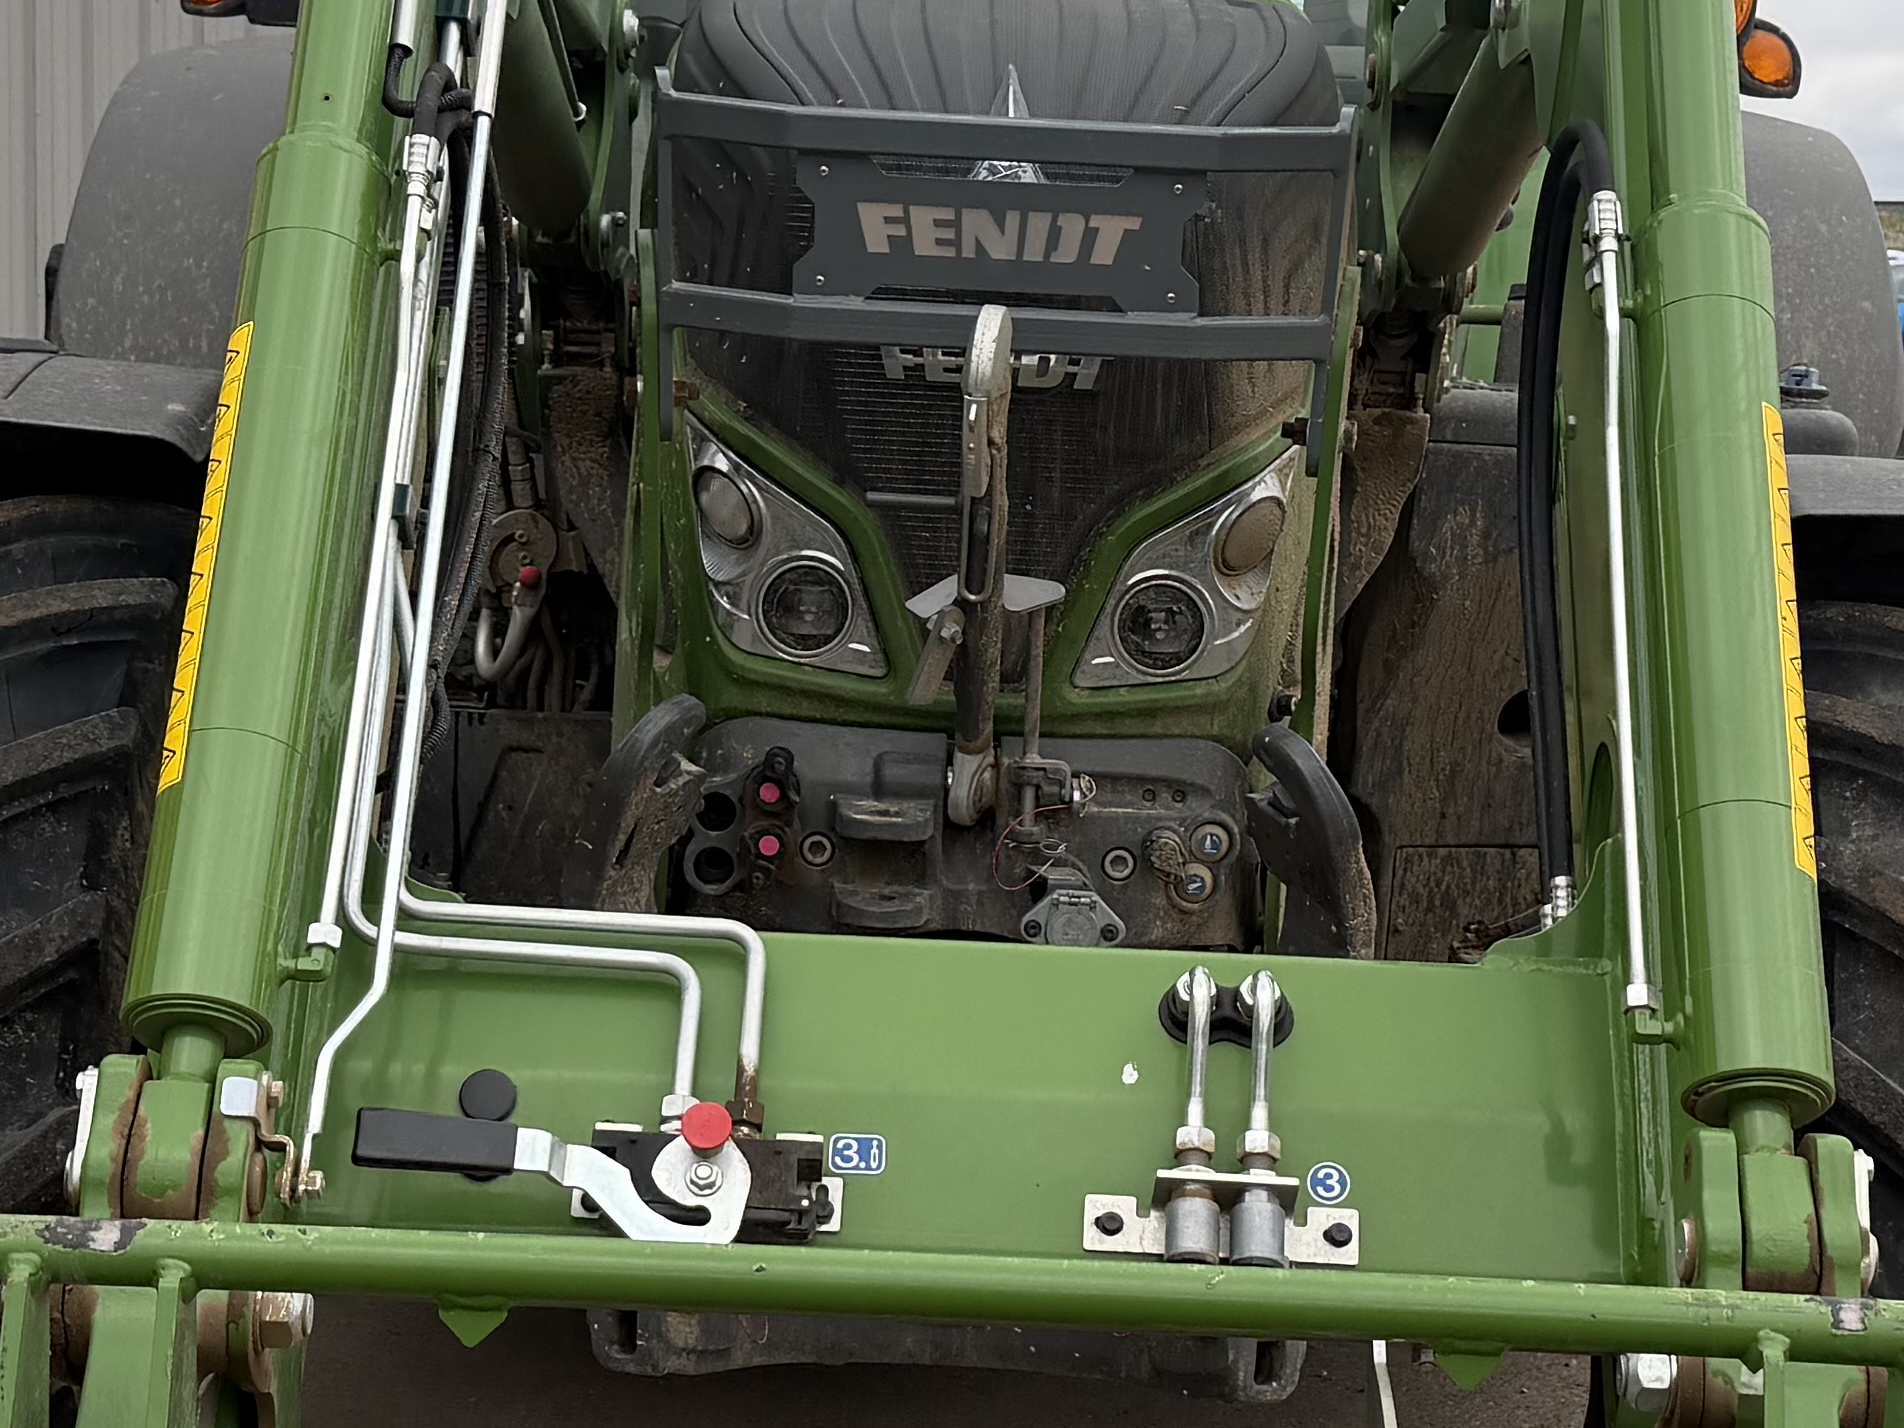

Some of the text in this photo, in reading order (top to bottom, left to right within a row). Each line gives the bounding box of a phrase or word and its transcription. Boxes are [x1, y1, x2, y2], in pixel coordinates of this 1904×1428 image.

[856, 201, 1143, 265] FENDT
[880, 344, 1115, 391] FEDT
[1316, 1167, 1341, 1198] 3
